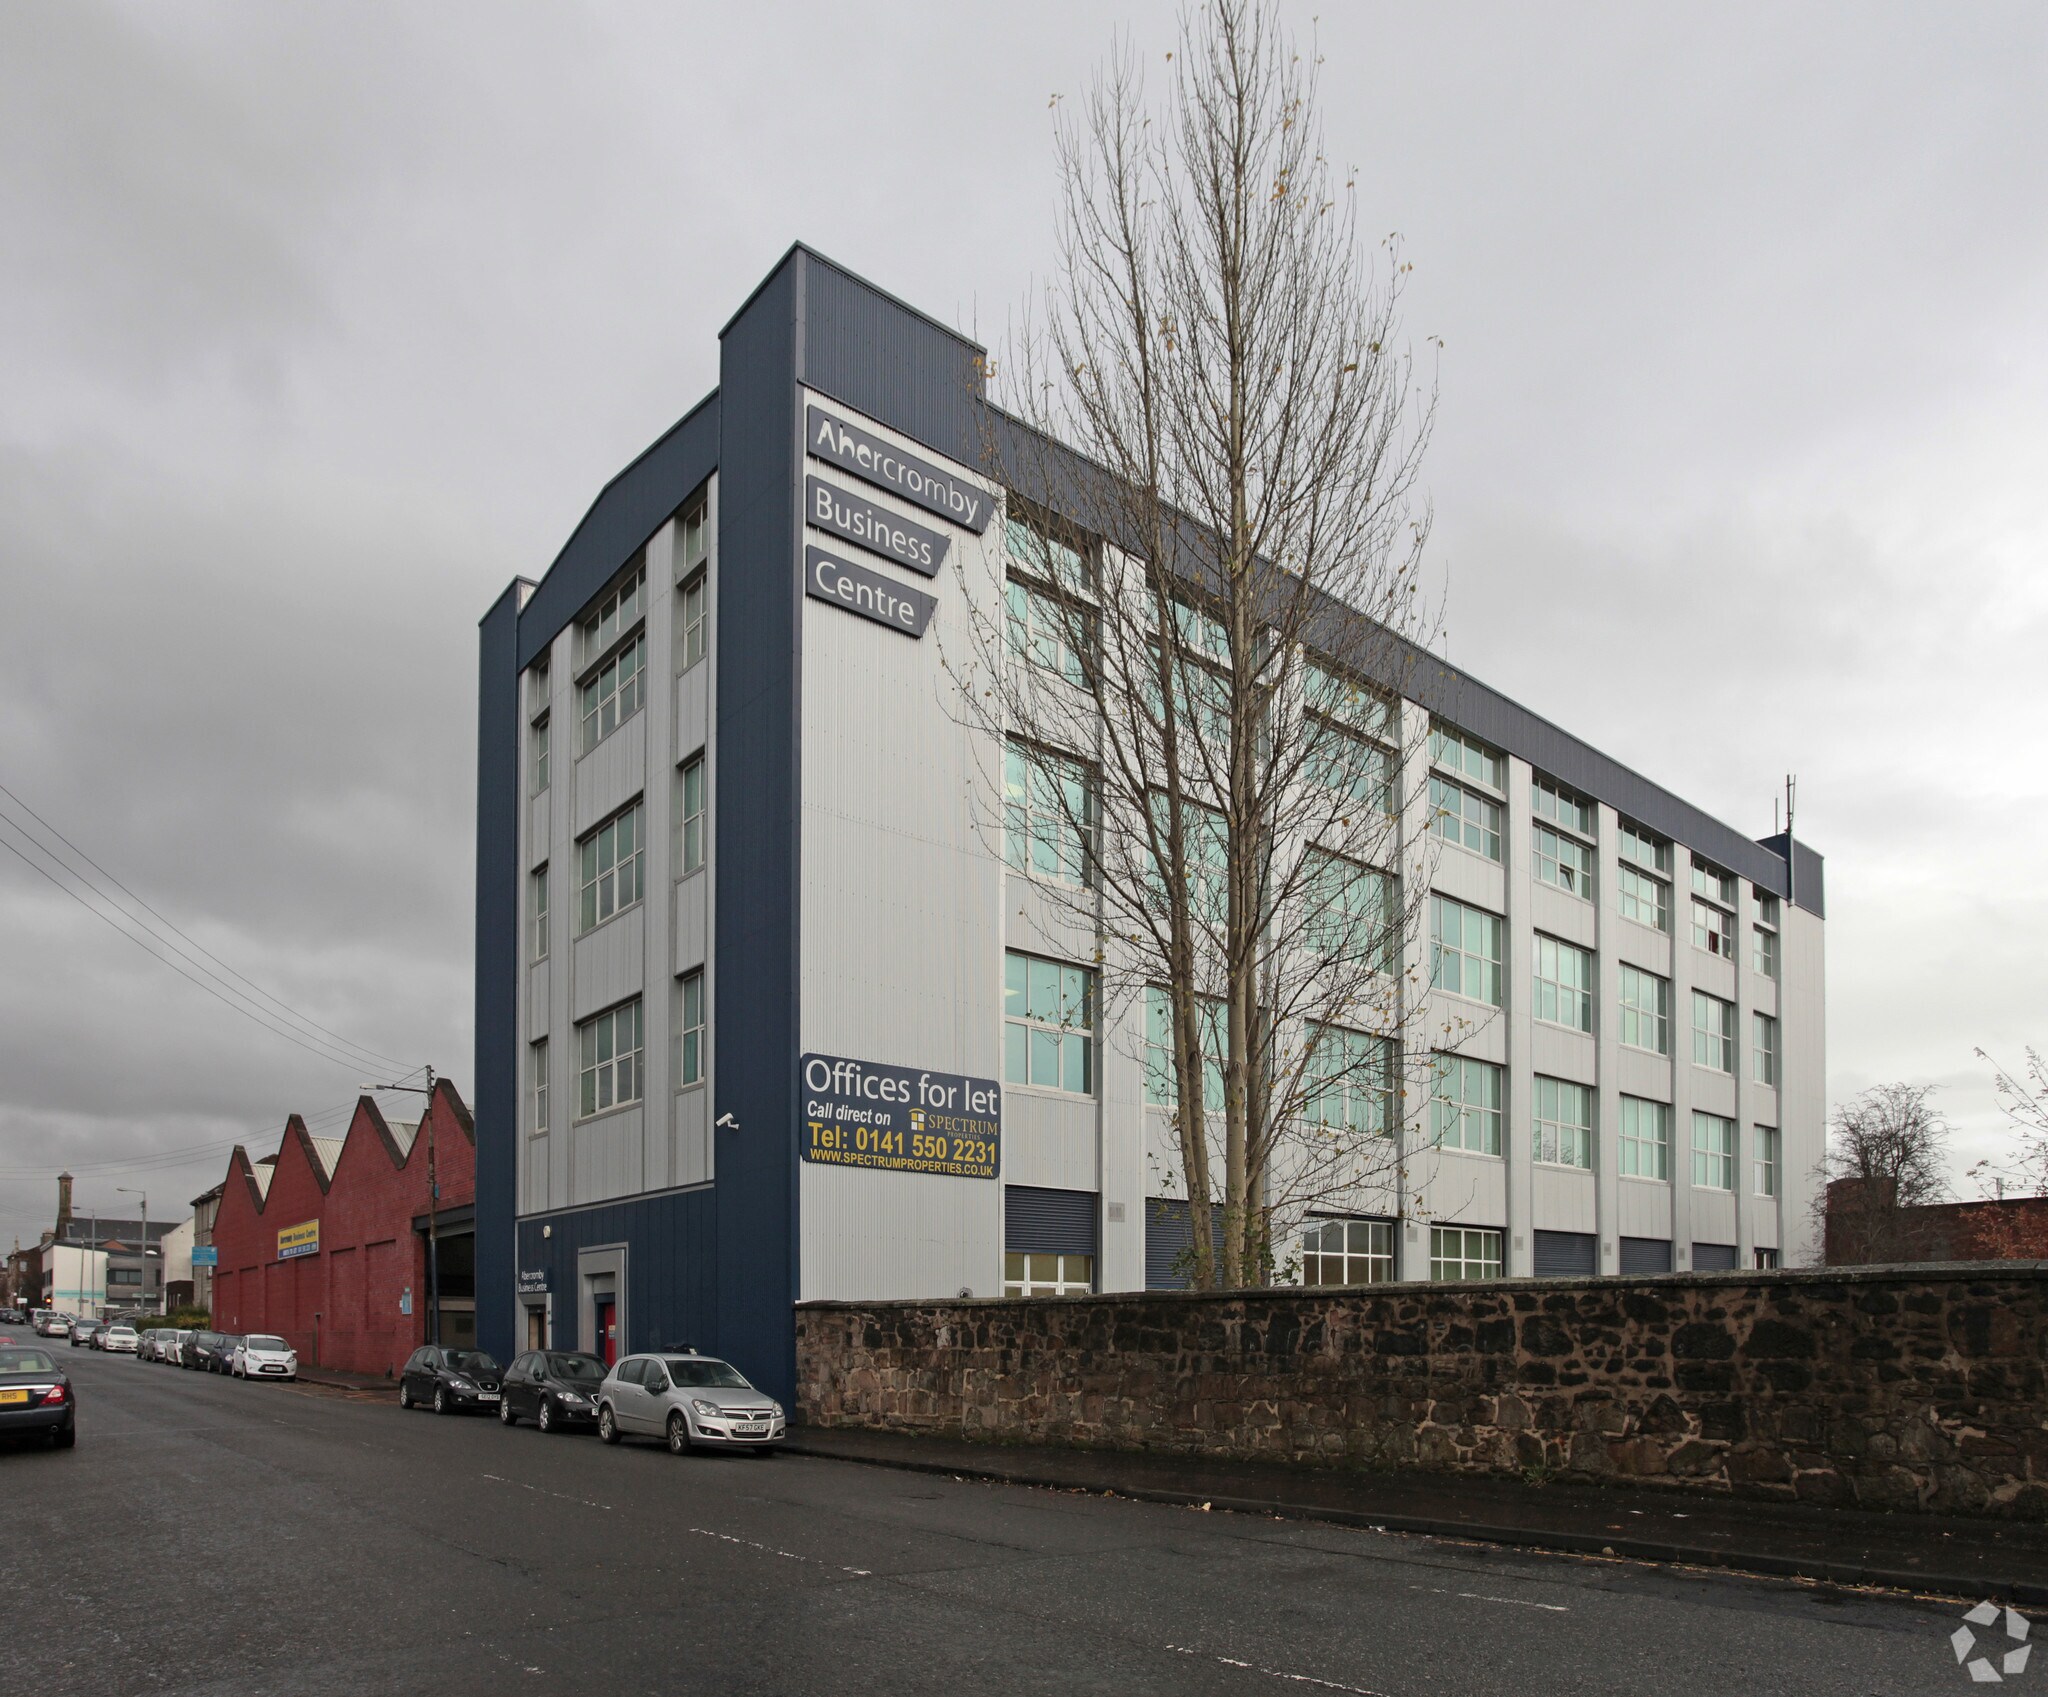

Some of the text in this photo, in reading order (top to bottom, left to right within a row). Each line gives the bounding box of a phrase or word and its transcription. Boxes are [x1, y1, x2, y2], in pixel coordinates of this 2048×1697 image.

[816, 487, 932, 565] Business
[815, 561, 915, 625] Centre
[805, 1059, 998, 1115] Offices for let
[807, 1100, 891, 1126] Call direct on
[928, 1114, 998, 1136] SPECTRUM
[808, 1122, 996, 1164] Tel: 0141 550 2231
[947, 1131, 981, 1140] PROPERTIES
[810, 1148, 994, 1176] WWW.SPECTRUMPROPERTIES.CO.UK
